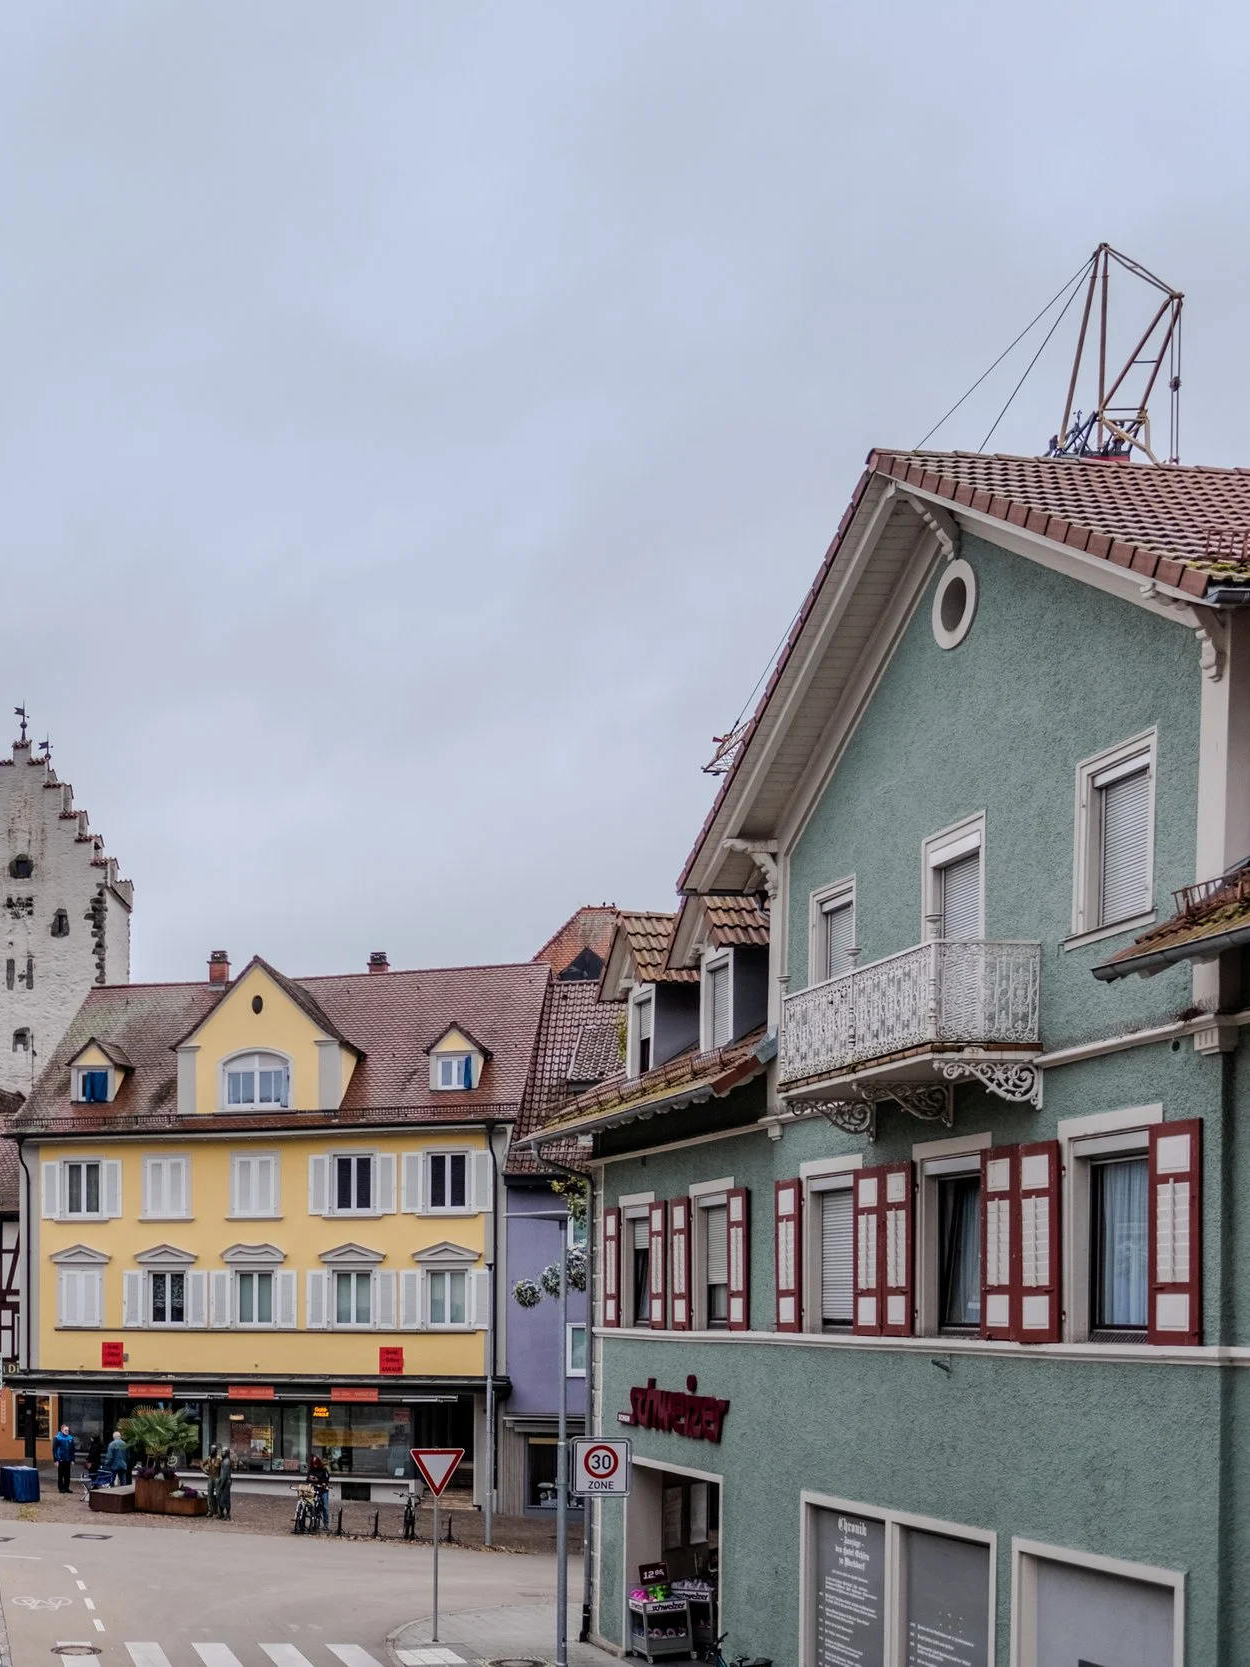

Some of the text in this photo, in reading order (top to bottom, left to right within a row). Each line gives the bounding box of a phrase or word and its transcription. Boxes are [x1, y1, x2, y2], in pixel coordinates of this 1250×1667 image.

[591, 1454, 612, 1470] 30
[588, 1480, 614, 1490] ZONE
[652, 1601, 685, 1612] schweizer
